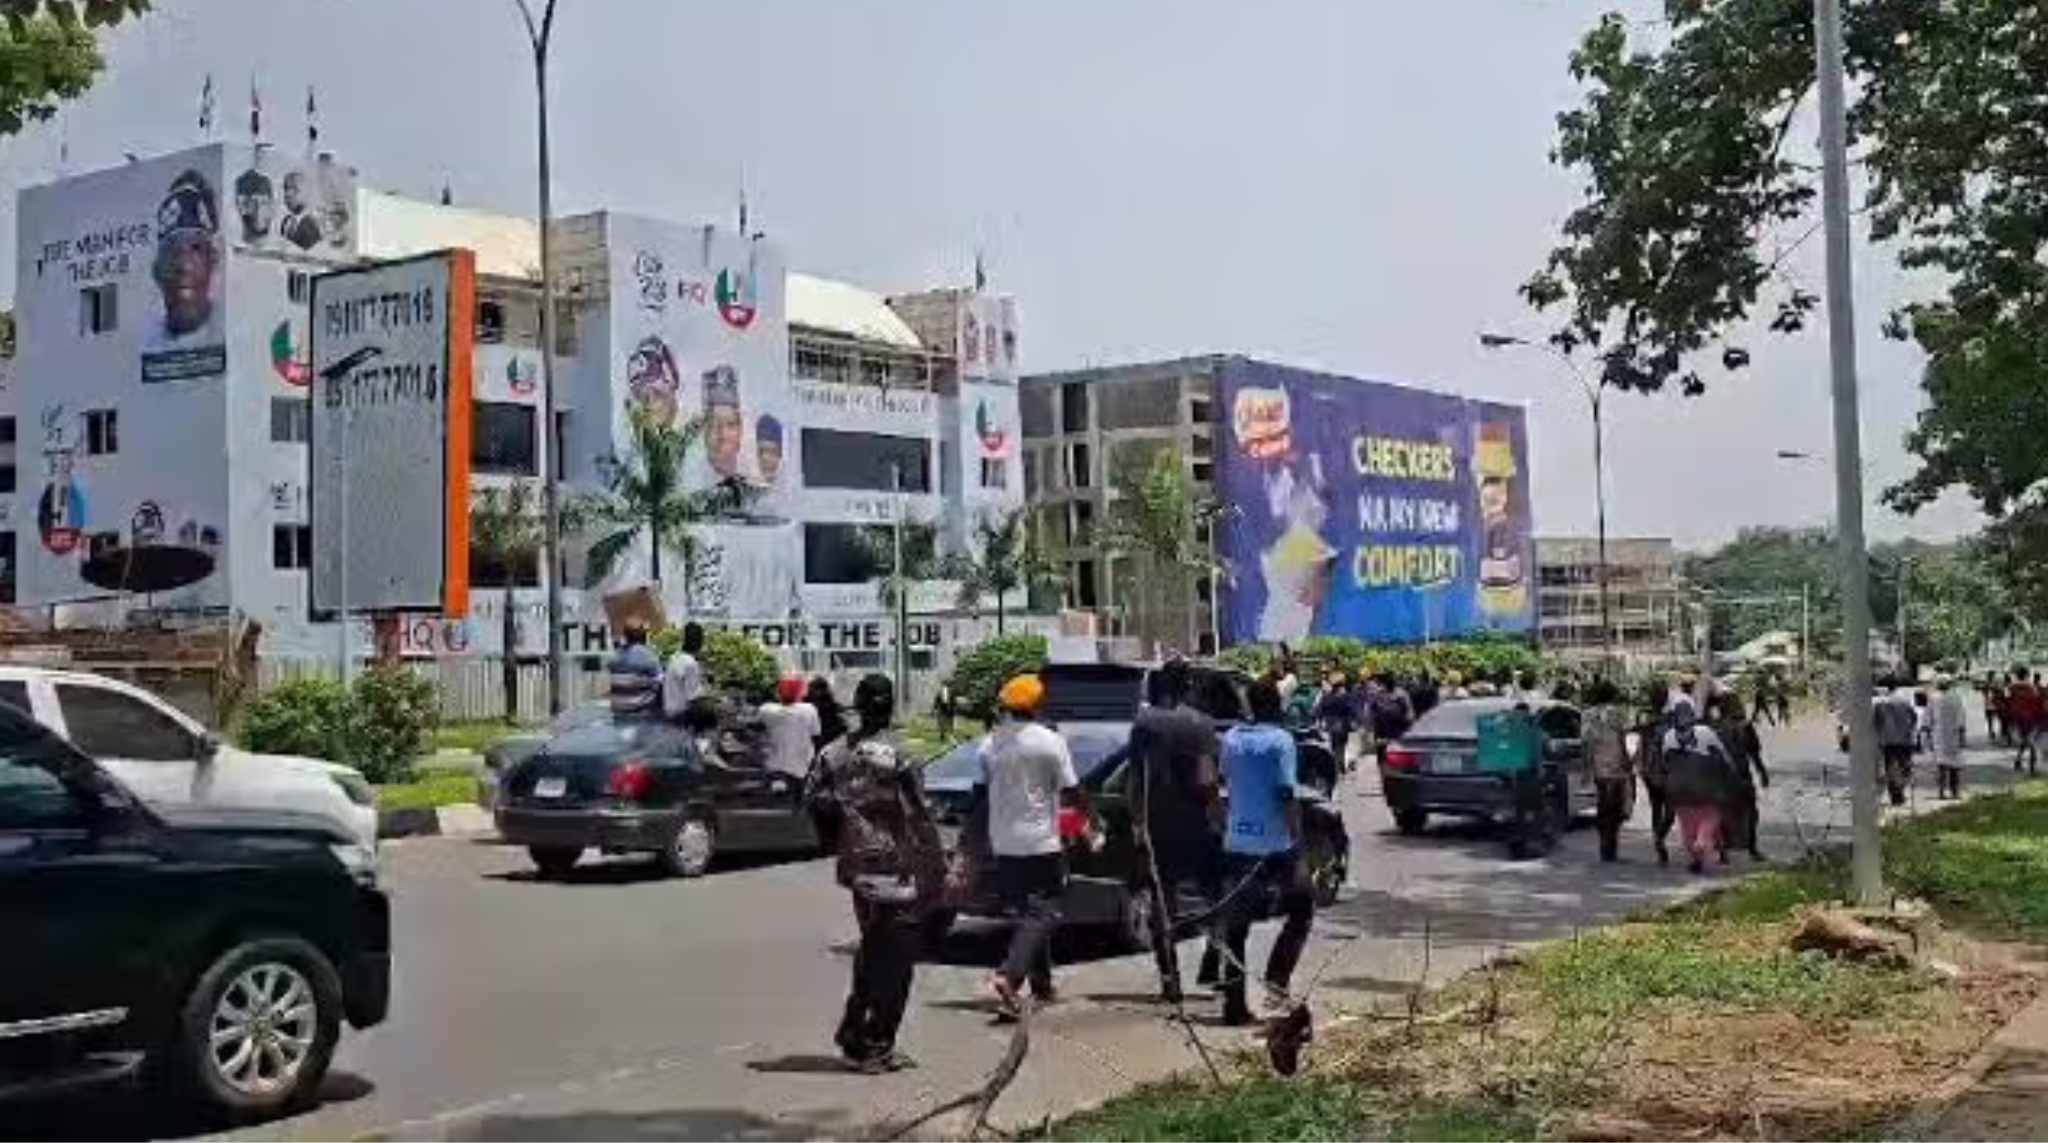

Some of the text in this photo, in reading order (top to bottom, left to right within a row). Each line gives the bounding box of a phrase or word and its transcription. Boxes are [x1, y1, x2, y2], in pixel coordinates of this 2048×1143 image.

[1353, 436, 1455, 480] CHECKERS
[1389, 498, 1414, 531] MY
[1419, 500, 1460, 532] NEW
[1354, 545, 1463, 587] COMFORT
[821, 623, 880, 648] THE
